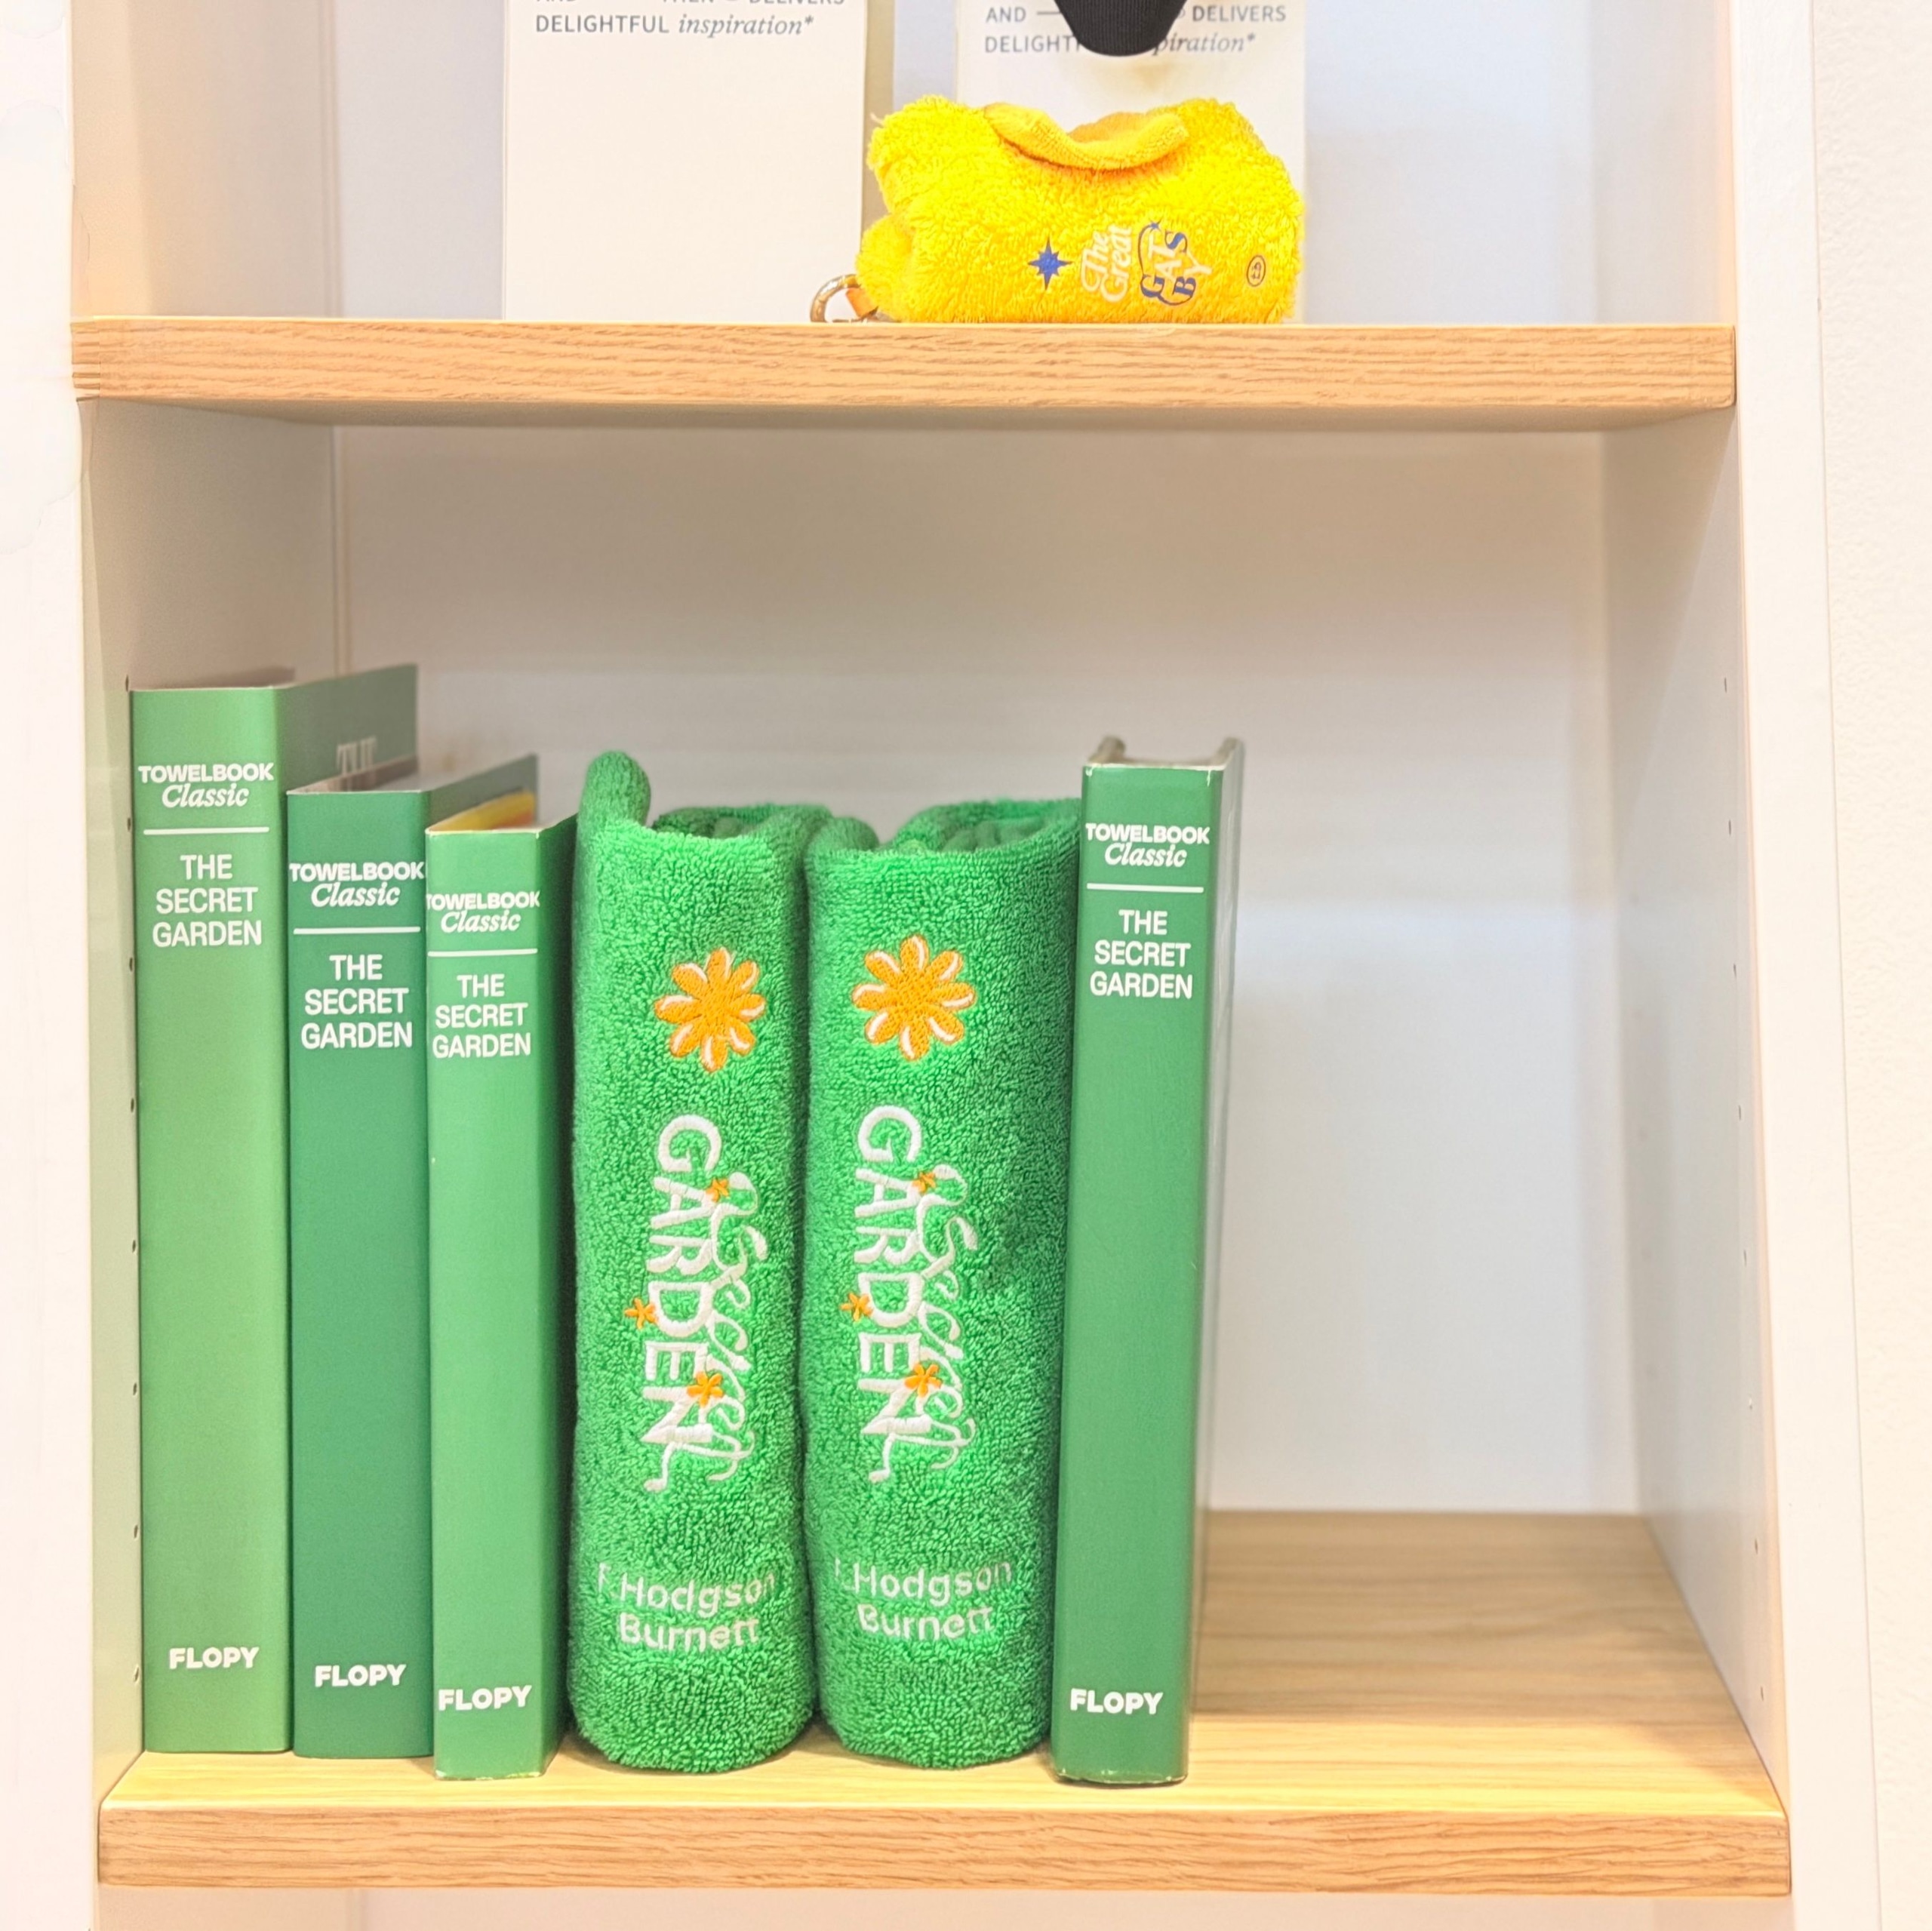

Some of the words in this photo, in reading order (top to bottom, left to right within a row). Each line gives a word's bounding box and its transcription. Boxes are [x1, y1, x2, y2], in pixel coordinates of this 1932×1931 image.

[536, 14, 669, 33] DELIGHTFUL
[986, 7, 1026, 23] AND
[1192, 5, 1286, 22] DELIVERS
[985, 36, 1081, 53] DELIGHT
[1081, 230, 1109, 293] The
[1100, 224, 1134, 303] Great
[138, 762, 274, 783] TOWELBOOK
[162, 783, 250, 808] Classic
[1085, 823, 1210, 845] TOWELBOOK
[180, 854, 233, 881] THE
[1104, 842, 1187, 867] Classic
[289, 862, 425, 882] TOWELBOOK
[156, 887, 259, 914] SECRET
[311, 881, 401, 908] Classic
[152, 920, 262, 948] GARDEN
[441, 909, 521, 933] Classic
[1118, 909, 1168, 935] THE
[1094, 939, 1192, 967] SECRET
[329, 954, 383, 981] THE
[457, 974, 505, 998] THE
[1090, 971, 1193, 999] GARDEN
[305, 988, 410, 1016] SECRET
[435, 1003, 528, 1029] SECRET
[301, 1022, 413, 1050] GARDEN
[432, 1032, 531, 1059] GARDEN
[640, 1115, 723, 1443] GARDEN
[854, 1105, 932, 1435] GARDEN
[868, 1164, 979, 1484] Secret
[853, 1562, 1012, 1607] Hodgson
[620, 1613, 760, 1652] Burnett
[857, 1604, 993, 1641] Burnett
[169, 1647, 260, 1669] FLOPY
[315, 1664, 408, 1687] FLOPY
[438, 1685, 532, 1711] FLOPY
[1070, 1688, 1164, 1714] FLOPY
